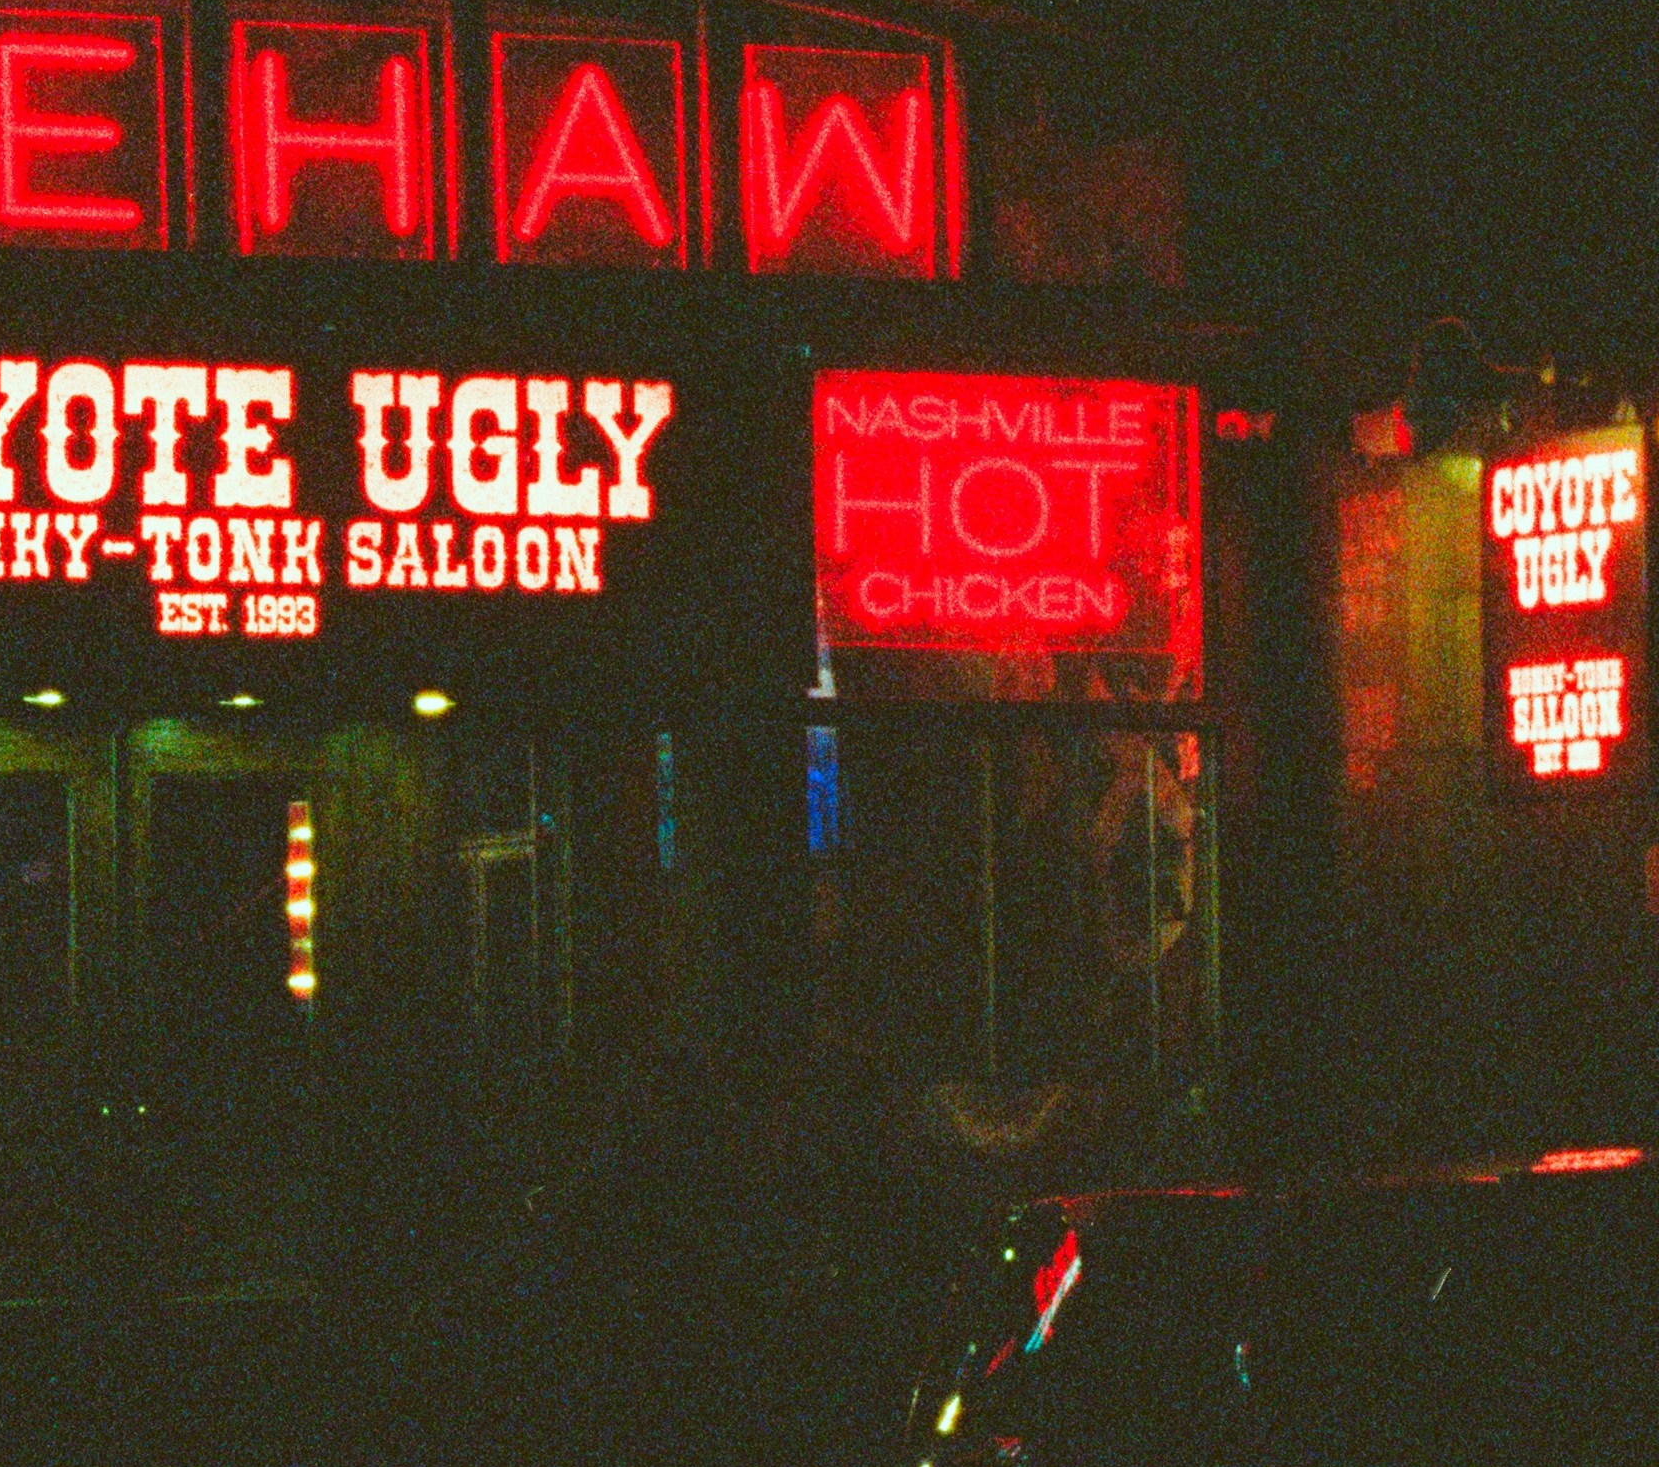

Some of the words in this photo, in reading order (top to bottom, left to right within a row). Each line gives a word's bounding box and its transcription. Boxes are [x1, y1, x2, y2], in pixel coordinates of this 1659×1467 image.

[352, 372, 671, 520] UGLY
[825, 393, 1146, 448] NASHVILLE
[833, 450, 1140, 560] HOT
[1492, 447, 1640, 537] COYOTE
[347, 521, 600, 591] SALOON
[1513, 528, 1612, 609] UGLY
[158, 591, 228, 633] EST.
[245, 594, 316, 635] 1993
[858, 570, 1119, 619] CHICKEN
[1512, 689, 1623, 744] SALOON
